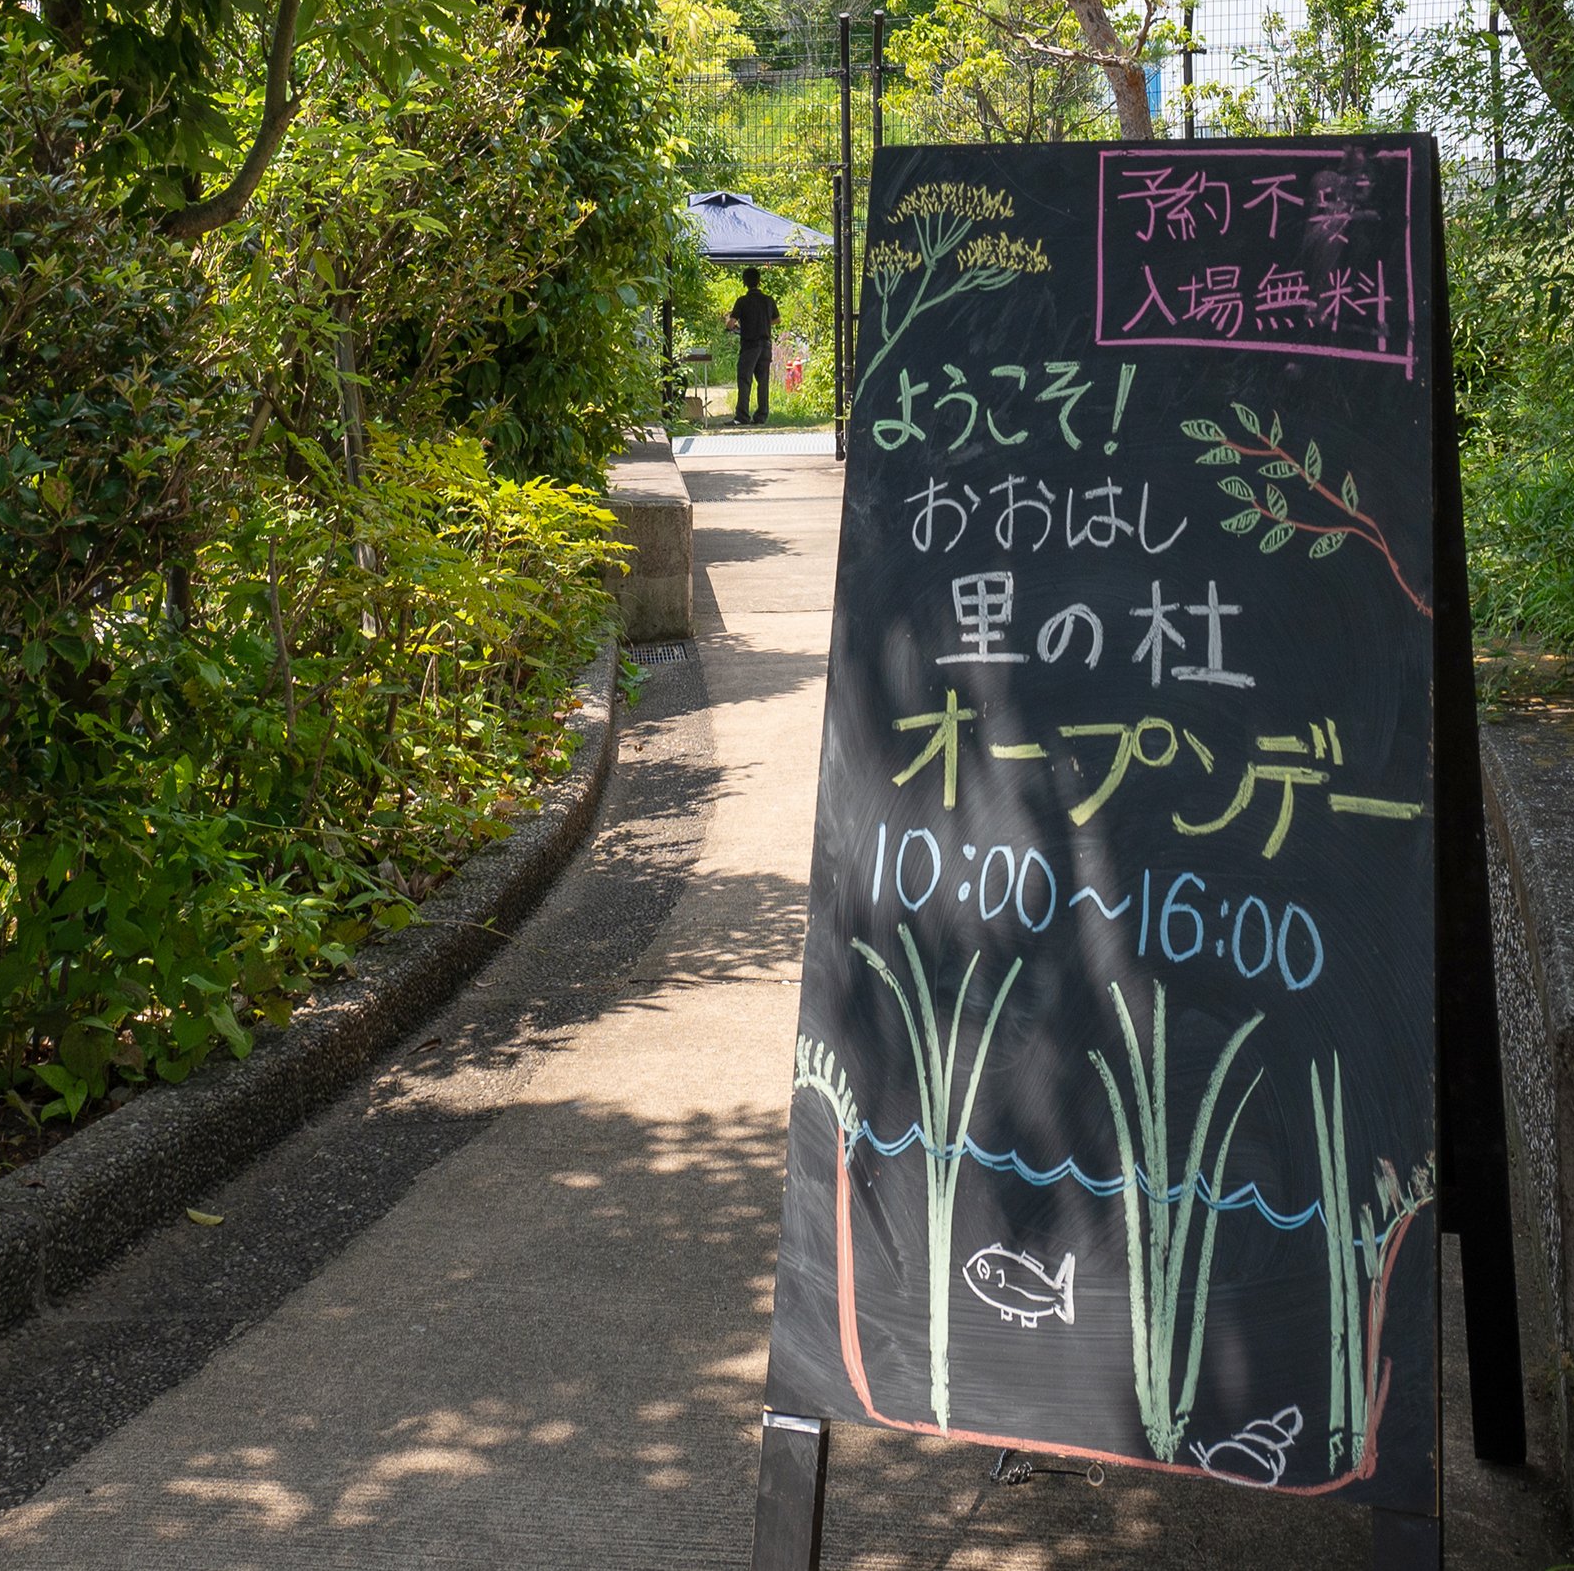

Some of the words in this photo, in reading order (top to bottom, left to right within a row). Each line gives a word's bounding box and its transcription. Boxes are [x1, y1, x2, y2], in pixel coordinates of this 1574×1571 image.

[1122, 260, 1392, 350] 入場無料
[904, 475, 1188, 554] おおはし
[935, 570, 1257, 689] 里の杜
[891, 687, 1425, 860] オープンデー
